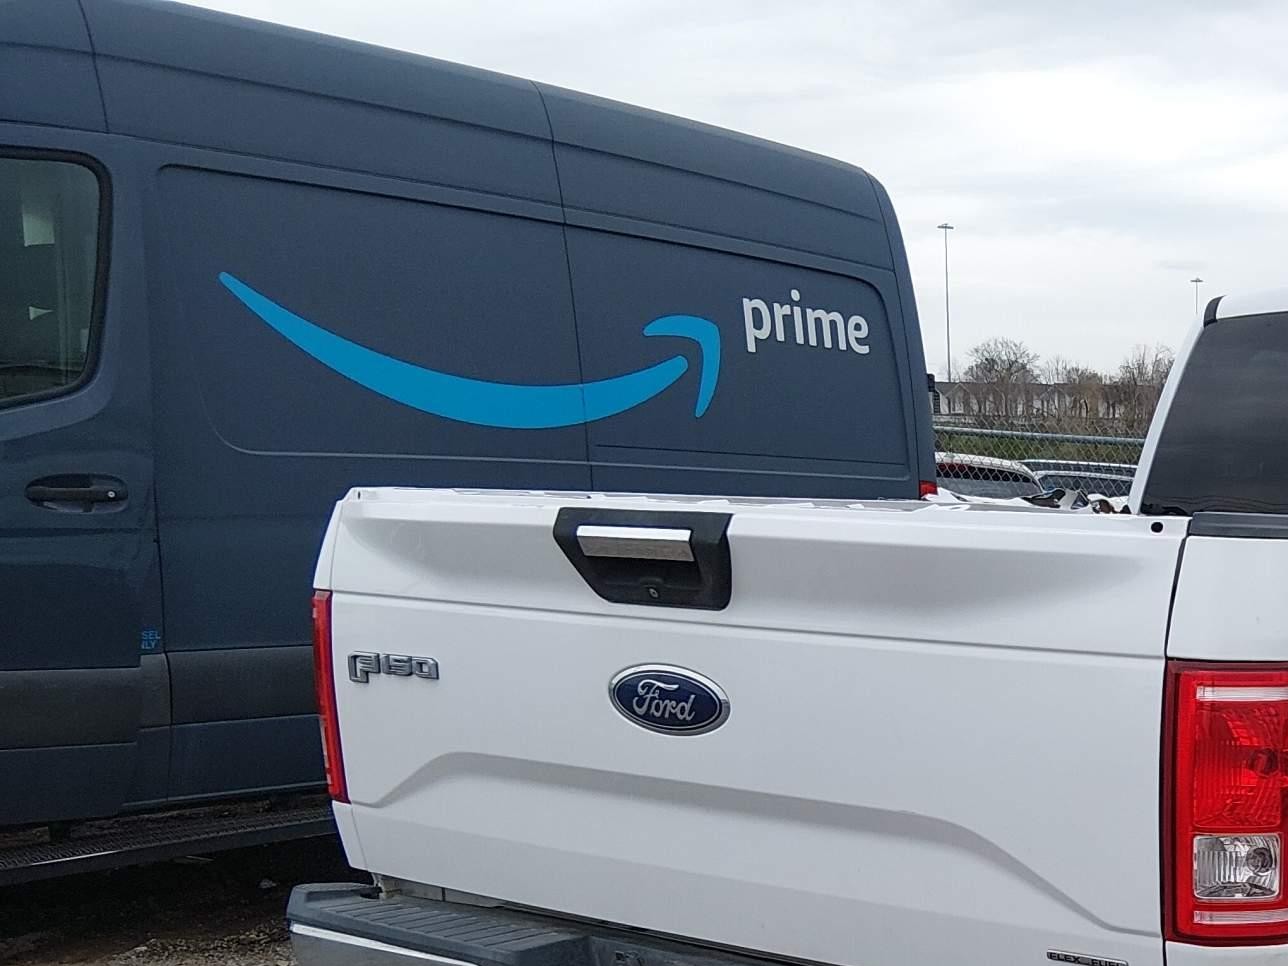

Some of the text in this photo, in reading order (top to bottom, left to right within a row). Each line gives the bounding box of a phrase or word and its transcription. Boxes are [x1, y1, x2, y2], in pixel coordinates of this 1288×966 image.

[742, 289, 870, 354] prime
[632, 679, 697, 721] Ford
[1048, 951, 1081, 965] FLEX
